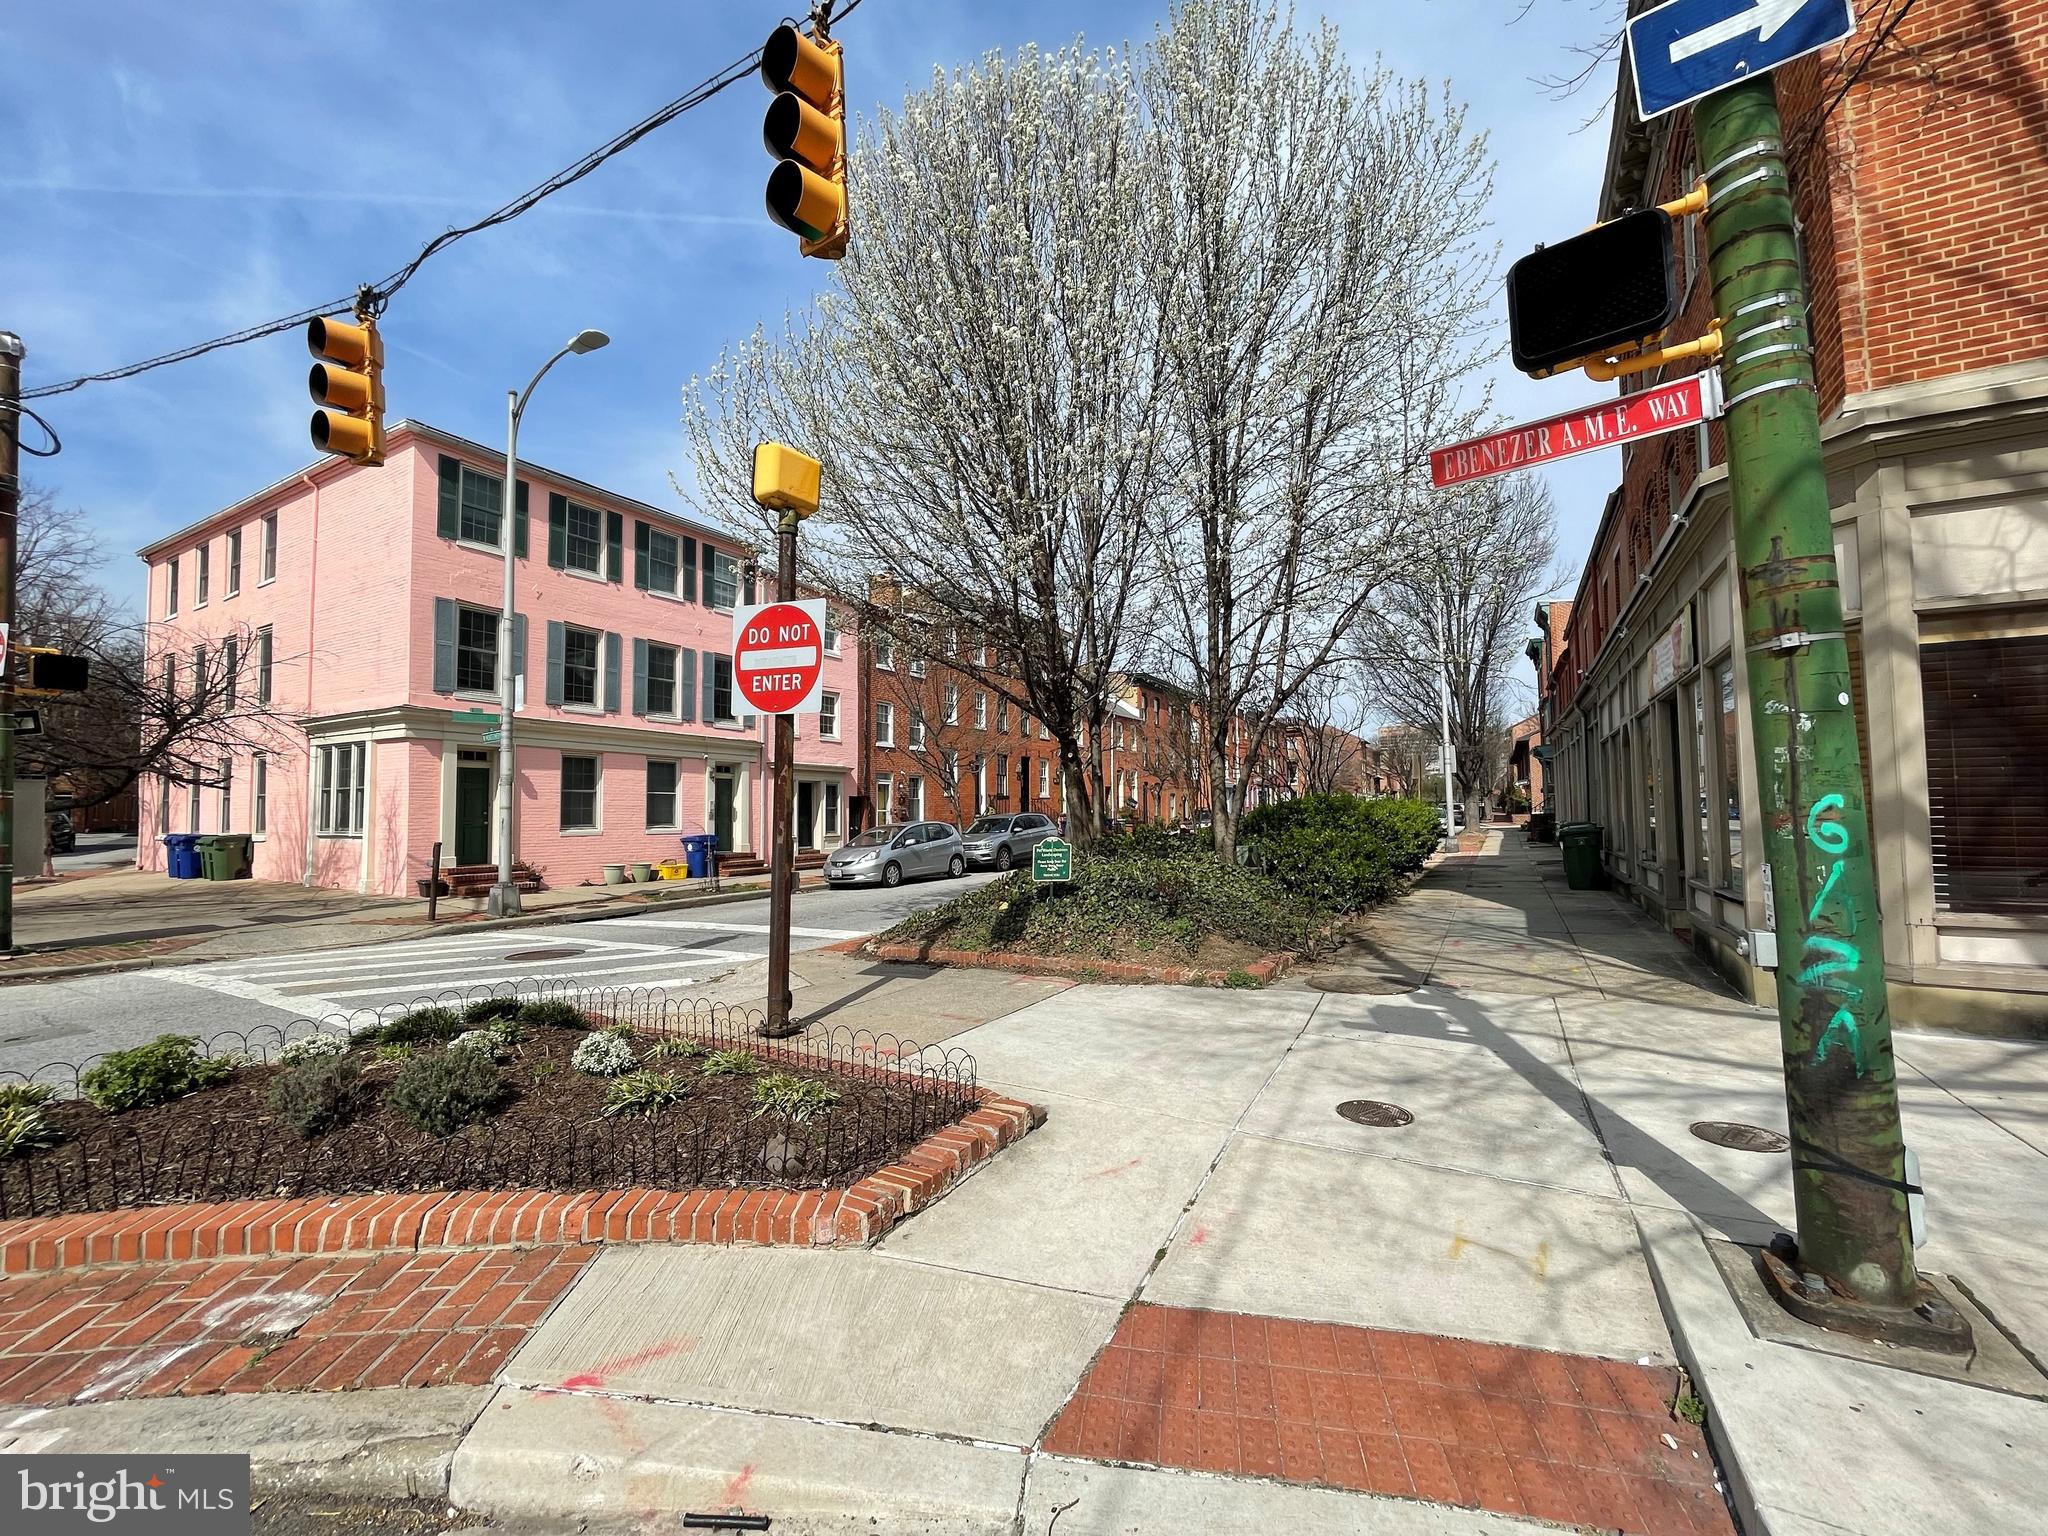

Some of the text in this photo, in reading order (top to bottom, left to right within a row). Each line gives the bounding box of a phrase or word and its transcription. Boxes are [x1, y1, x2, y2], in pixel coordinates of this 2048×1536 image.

[1442, 389, 1690, 481] EBENEZER A.M.E. WAY
[748, 623, 811, 645] DO NOT
[752, 673, 802, 693] ENTER
